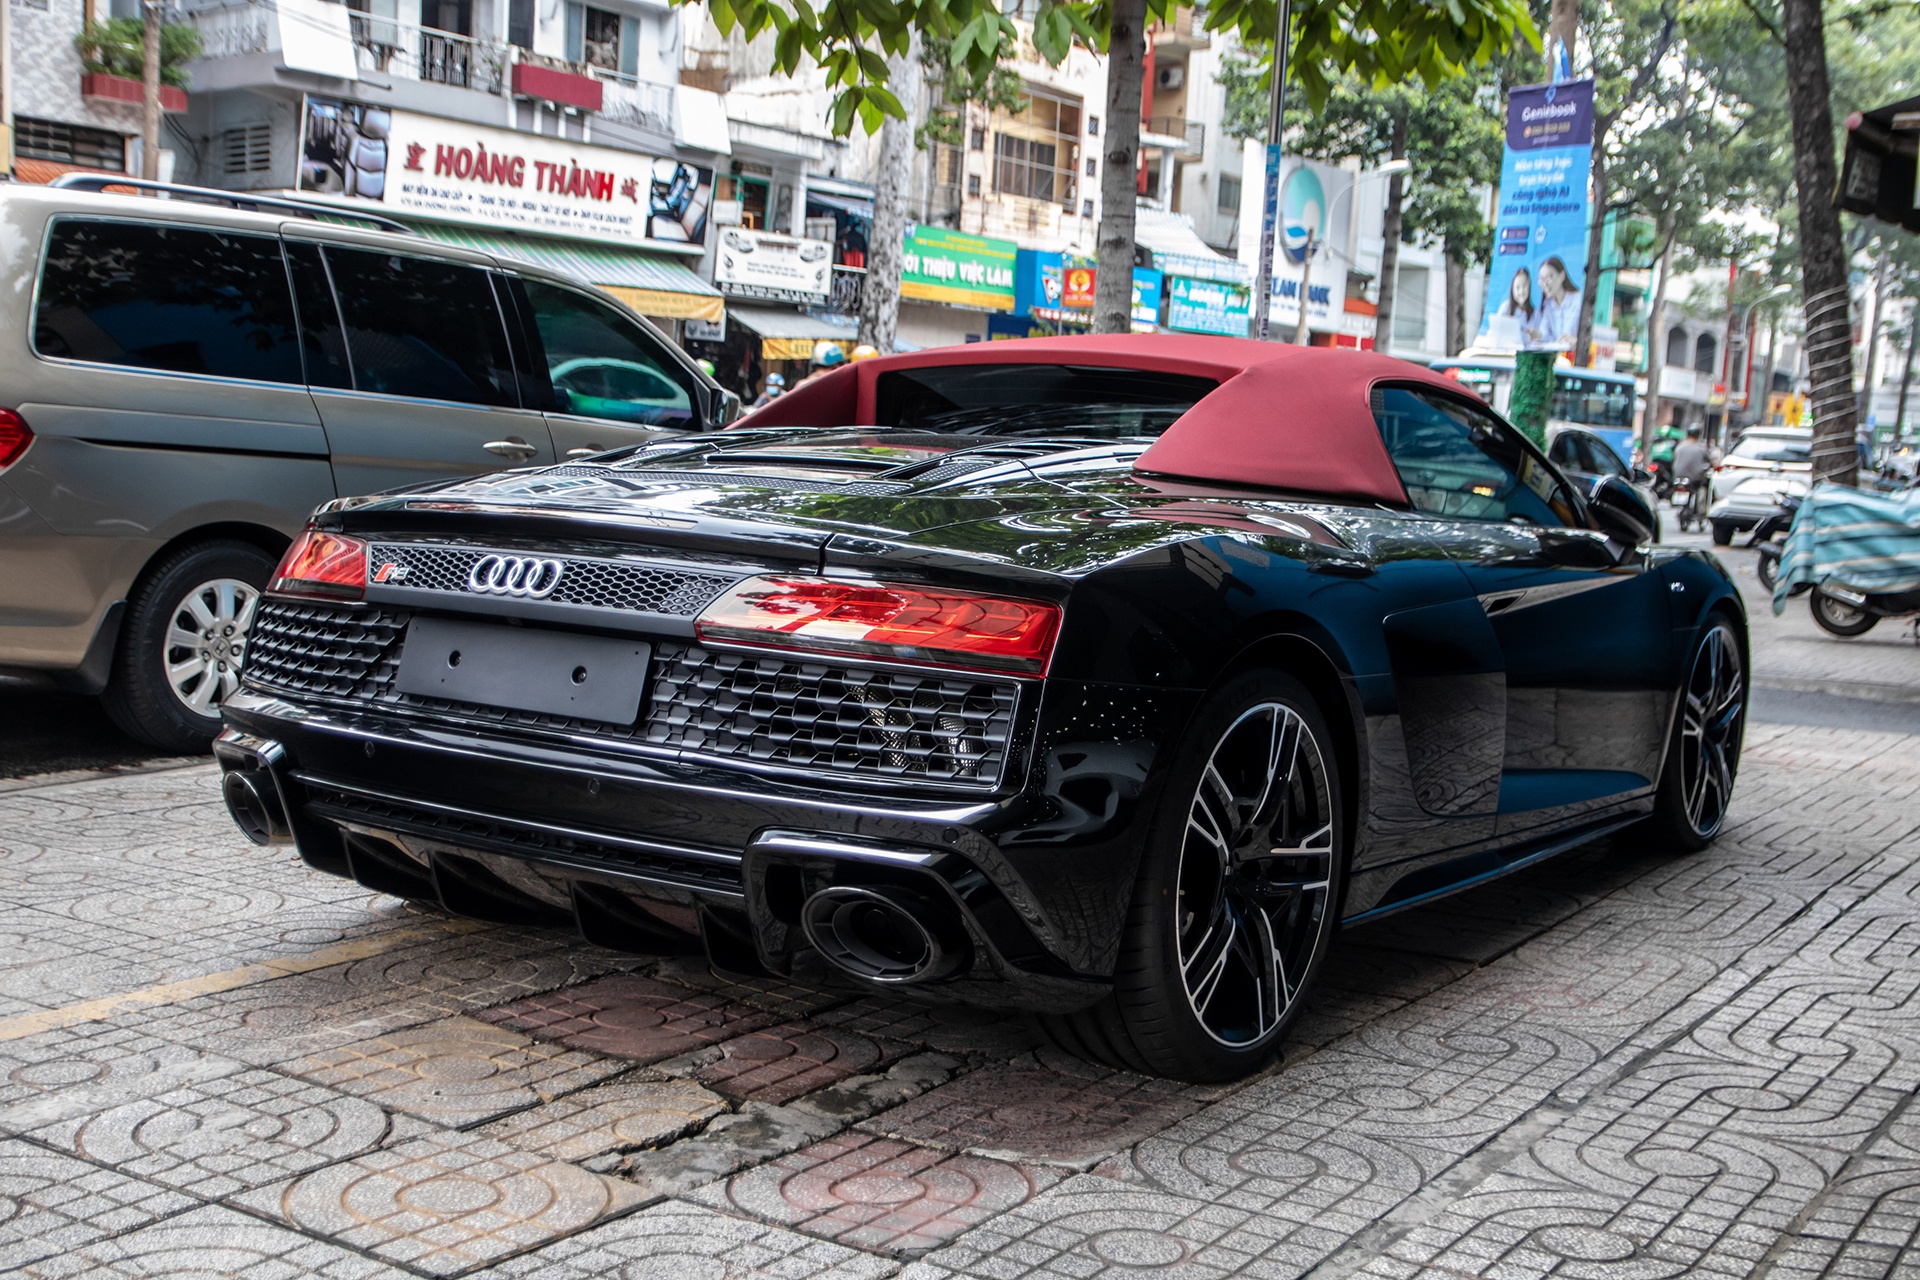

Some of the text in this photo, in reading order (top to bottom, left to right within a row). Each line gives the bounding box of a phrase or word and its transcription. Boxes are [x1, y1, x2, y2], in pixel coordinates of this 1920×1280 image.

[435, 142, 525, 187] HOÀNG
[534, 158, 614, 201] THÀNH
[1558, 185, 1570, 197] AI
[384, 566, 410, 580] R8
